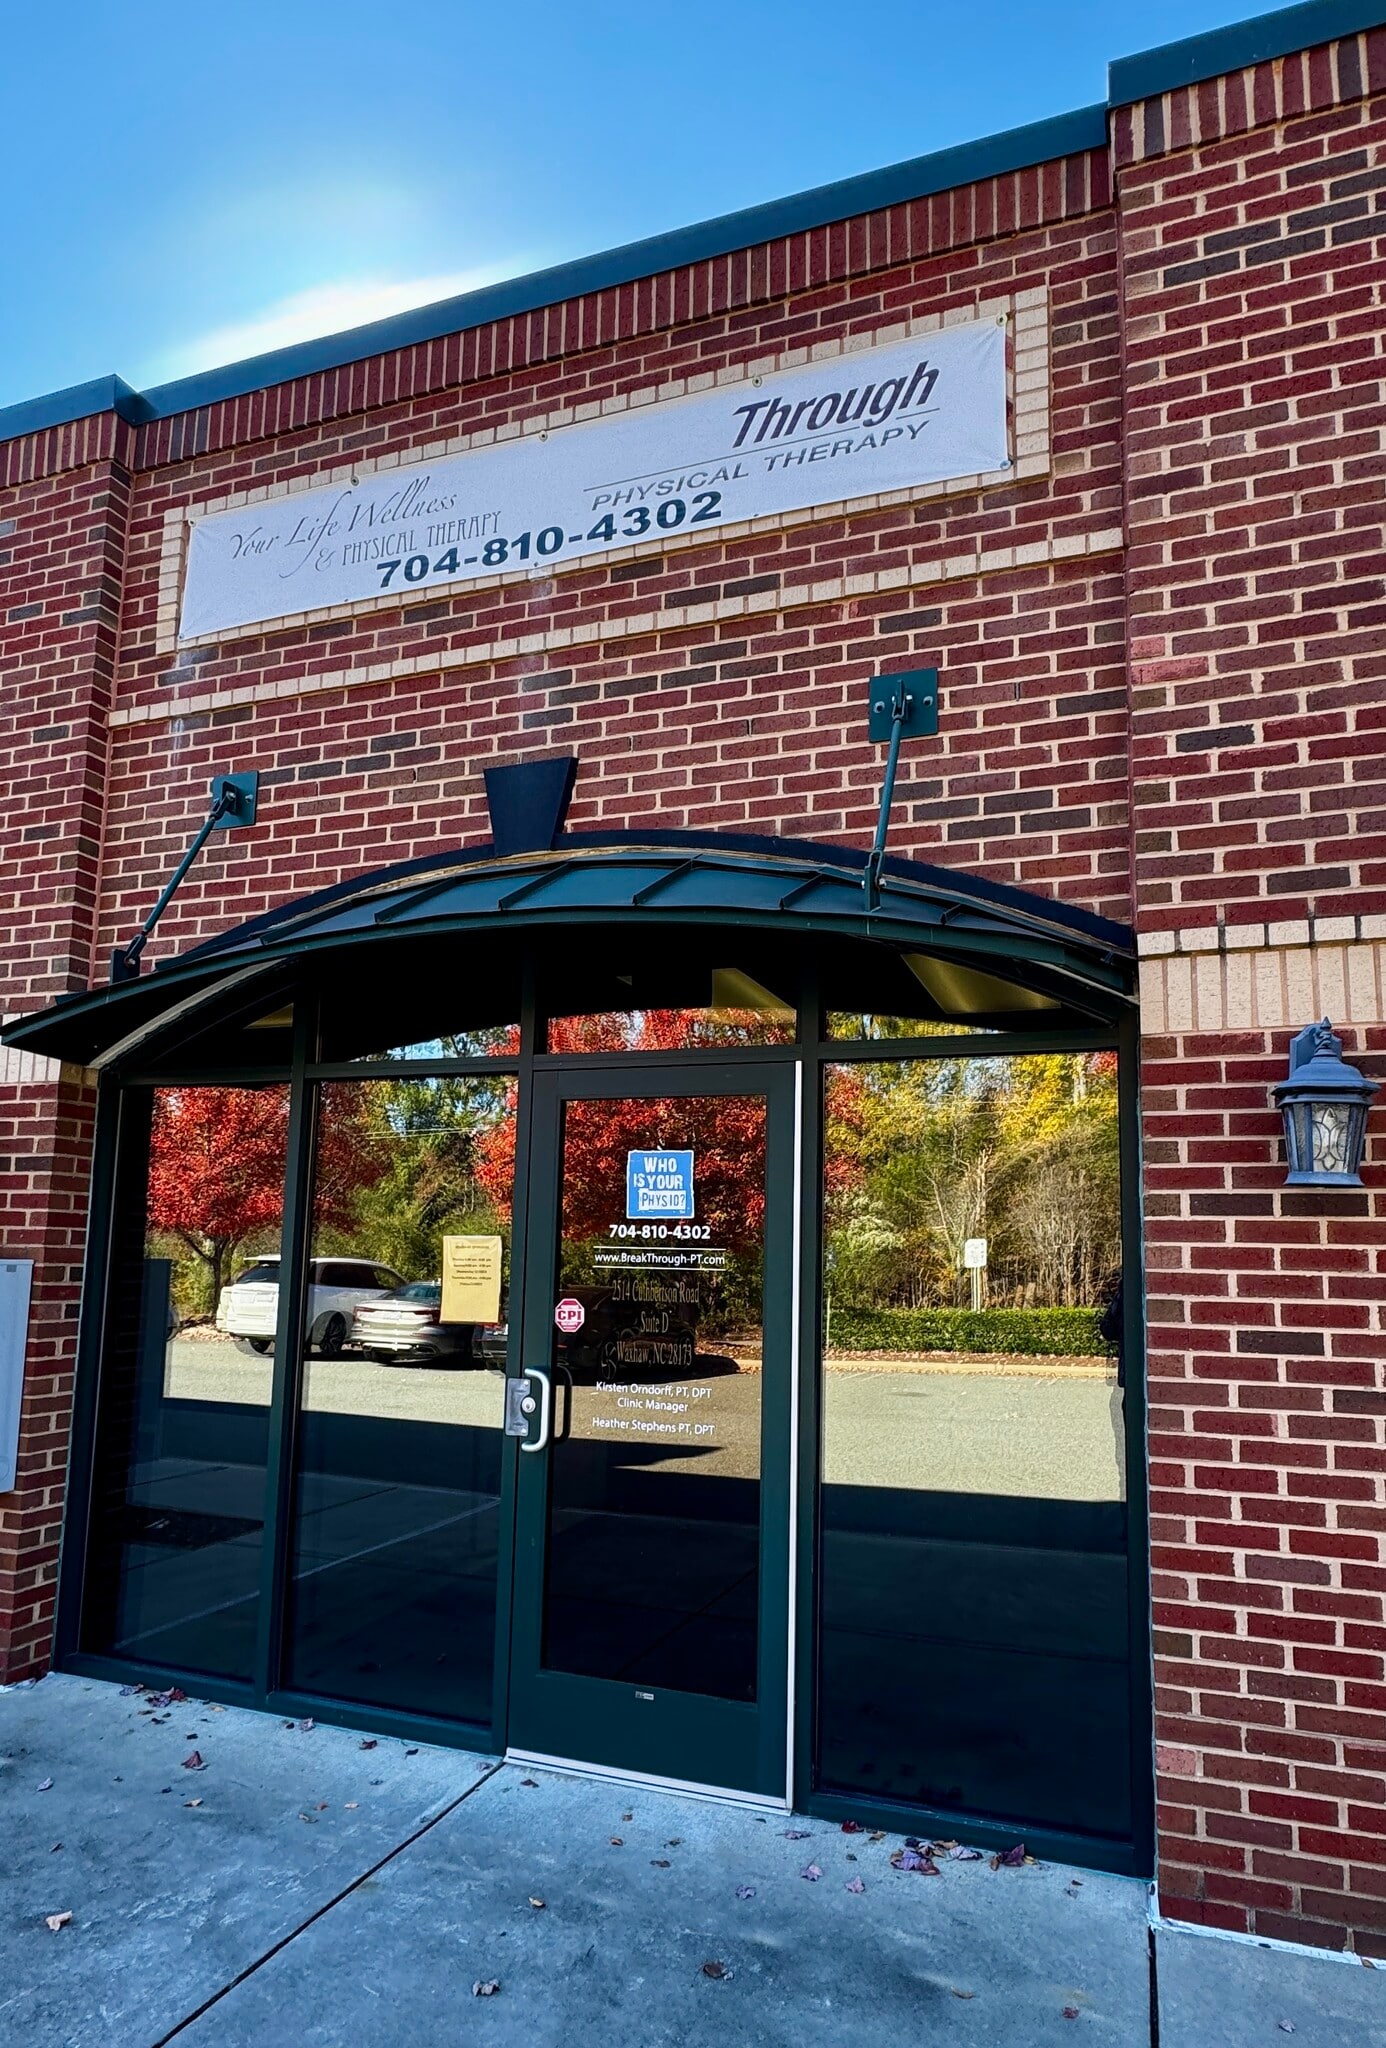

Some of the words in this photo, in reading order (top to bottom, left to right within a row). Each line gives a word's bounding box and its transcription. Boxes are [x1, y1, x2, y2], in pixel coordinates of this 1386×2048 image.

[731, 360, 940, 448] Through
[591, 462, 750, 511] PHYSICAL
[764, 419, 930, 473] THERAPY
[229, 529, 279, 561] Your
[277, 490, 352, 578] Life
[348, 475, 457, 532] Wellness
[315, 548, 335, 572] &
[342, 529, 418, 566] PHYSICAL
[426, 510, 502, 548] THERAPY
[376, 490, 723, 588] 704-810-4302
[643, 1157, 677, 1173] WHO
[633, 1173, 645, 1188] IS
[646, 1174, 683, 1190] YOUR
[640, 1191, 686, 1208] PHYSIO?
[609, 1224, 711, 1240] 704-810-4302
[594, 1252, 726, 1267] www.BreakThrough-PT.com
[612, 1279, 631, 1301] 2514
[679, 1281, 700, 1304] Road
[557, 1310, 582, 1321] CPI
[640, 1310, 660, 1333] Suite
[662, 1311, 669, 1333] D
[653, 1342, 667, 1365] NC
[668, 1343, 692, 1366] 28173
[596, 1382, 628, 1394] Kirsten
[630, 1383, 674, 1398] Orndorff,
[676, 1386, 689, 1399] PT,
[692, 1387, 712, 1399] DPT
[617, 1397, 643, 1409] Clinic
[646, 1399, 689, 1415] Manager
[592, 1417, 630, 1430] Heather
[632, 1419, 676, 1434] Stephens
[678, 1422, 692, 1435] PT,
[695, 1424, 715, 1436] DPT
